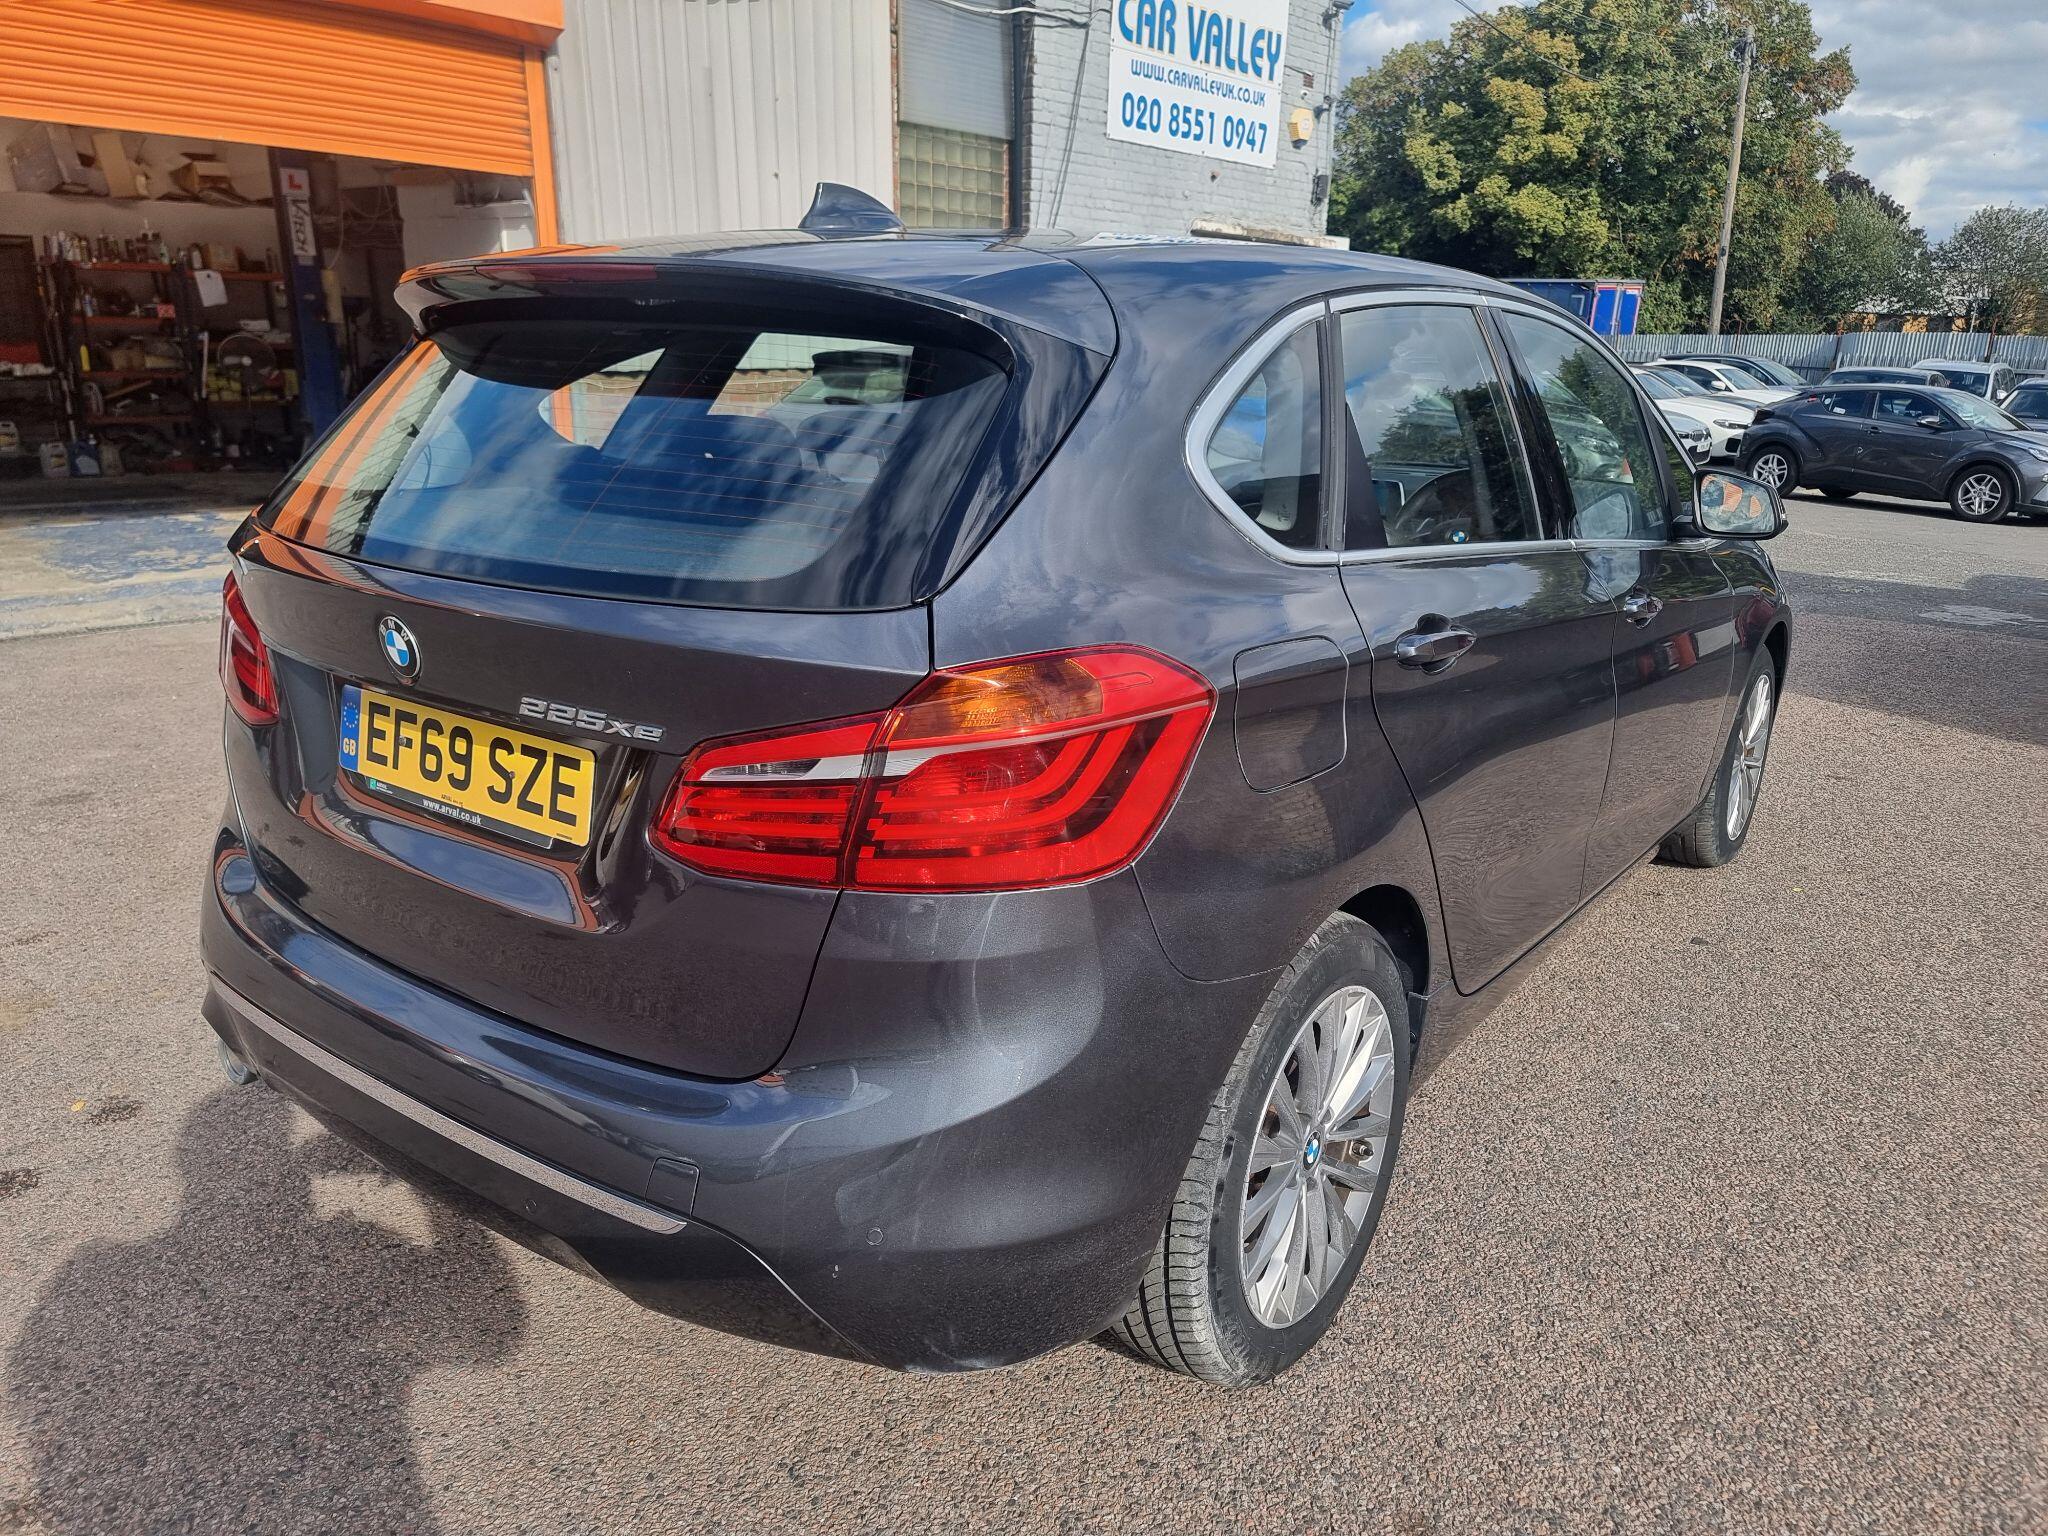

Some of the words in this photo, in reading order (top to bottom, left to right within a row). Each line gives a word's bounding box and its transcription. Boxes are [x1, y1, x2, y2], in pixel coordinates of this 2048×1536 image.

[1118, 0, 1176, 55] CAR
[1188, 5, 1282, 82] VALLEY
[1121, 91, 1162, 133] 020
[1168, 102, 1215, 144] 8551
[1222, 115, 1268, 154] 0947
[342, 737, 357, 757] GB
[366, 701, 474, 791] EF69
[487, 736, 582, 827] SZE
[422, 798, 482, 826] www.arval.co.uk
